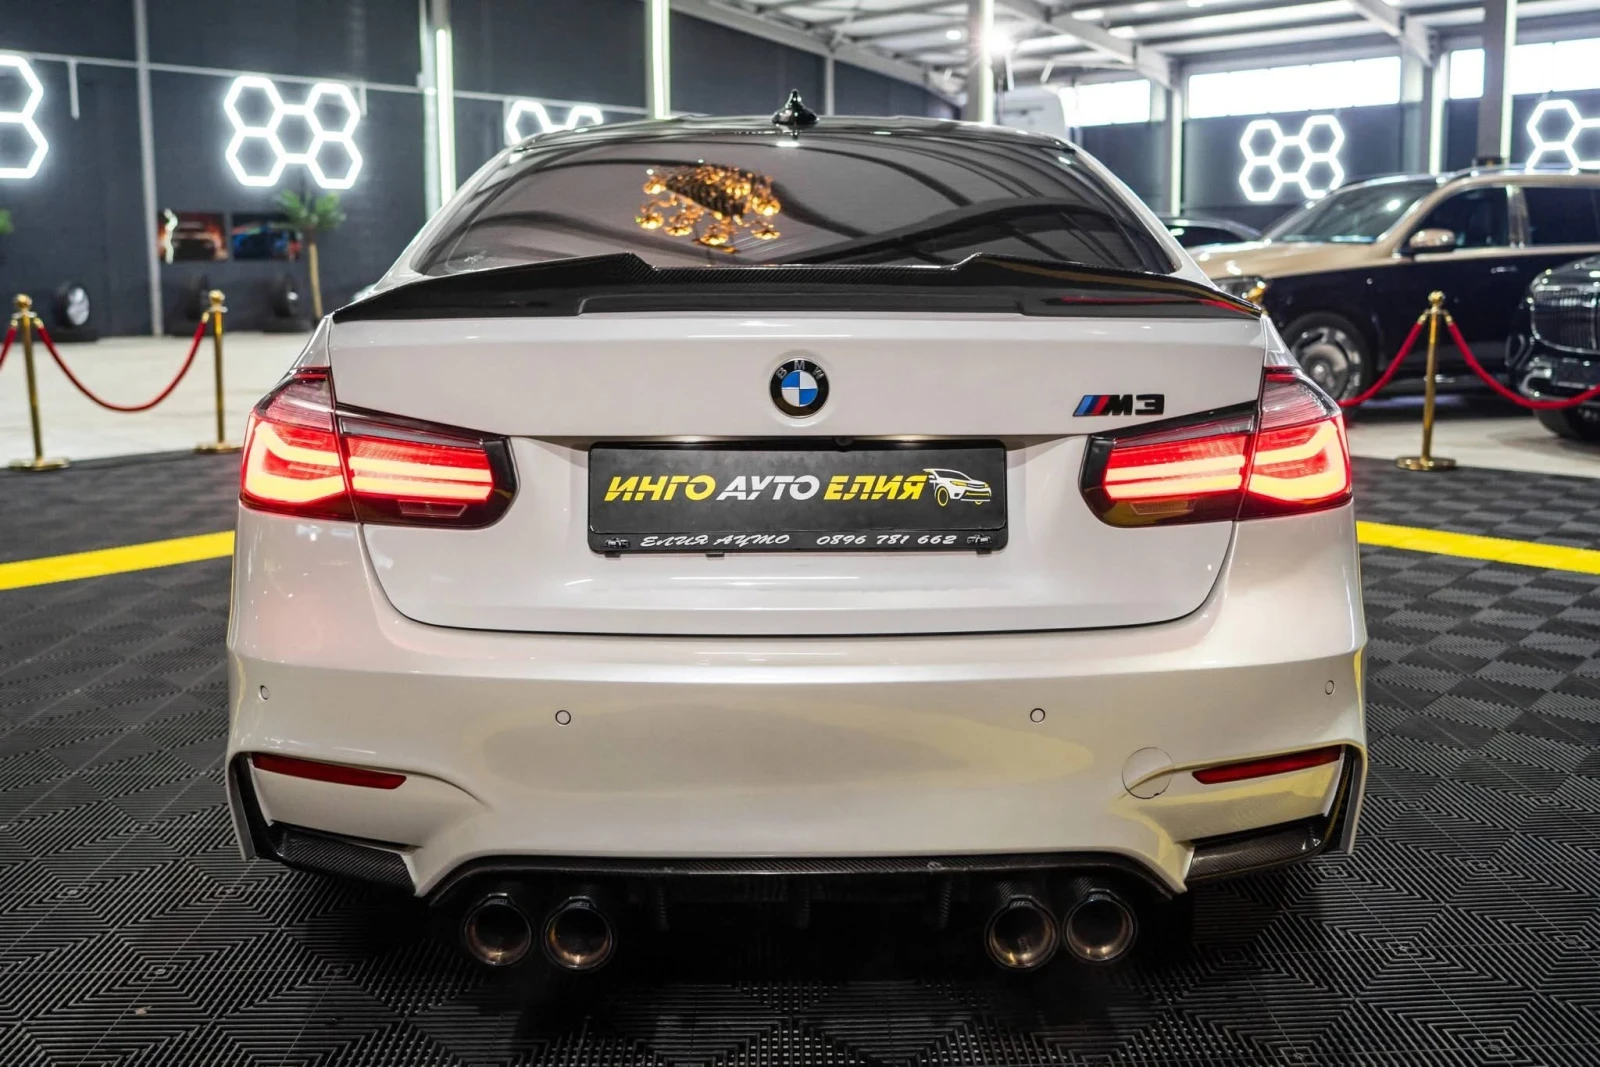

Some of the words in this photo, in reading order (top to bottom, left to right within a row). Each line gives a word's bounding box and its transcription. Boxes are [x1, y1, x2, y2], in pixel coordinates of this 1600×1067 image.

[776, 360, 825, 380] BMW
[1094, 393, 1165, 417] M3
[604, 475, 716, 502] ИНГО
[716, 474, 820, 501] АУТО
[823, 474, 929, 501] ЕЛИЯ
[817, 535, 867, 546] 0896
[876, 534, 909, 546] 781
[917, 534, 958, 546] 662
